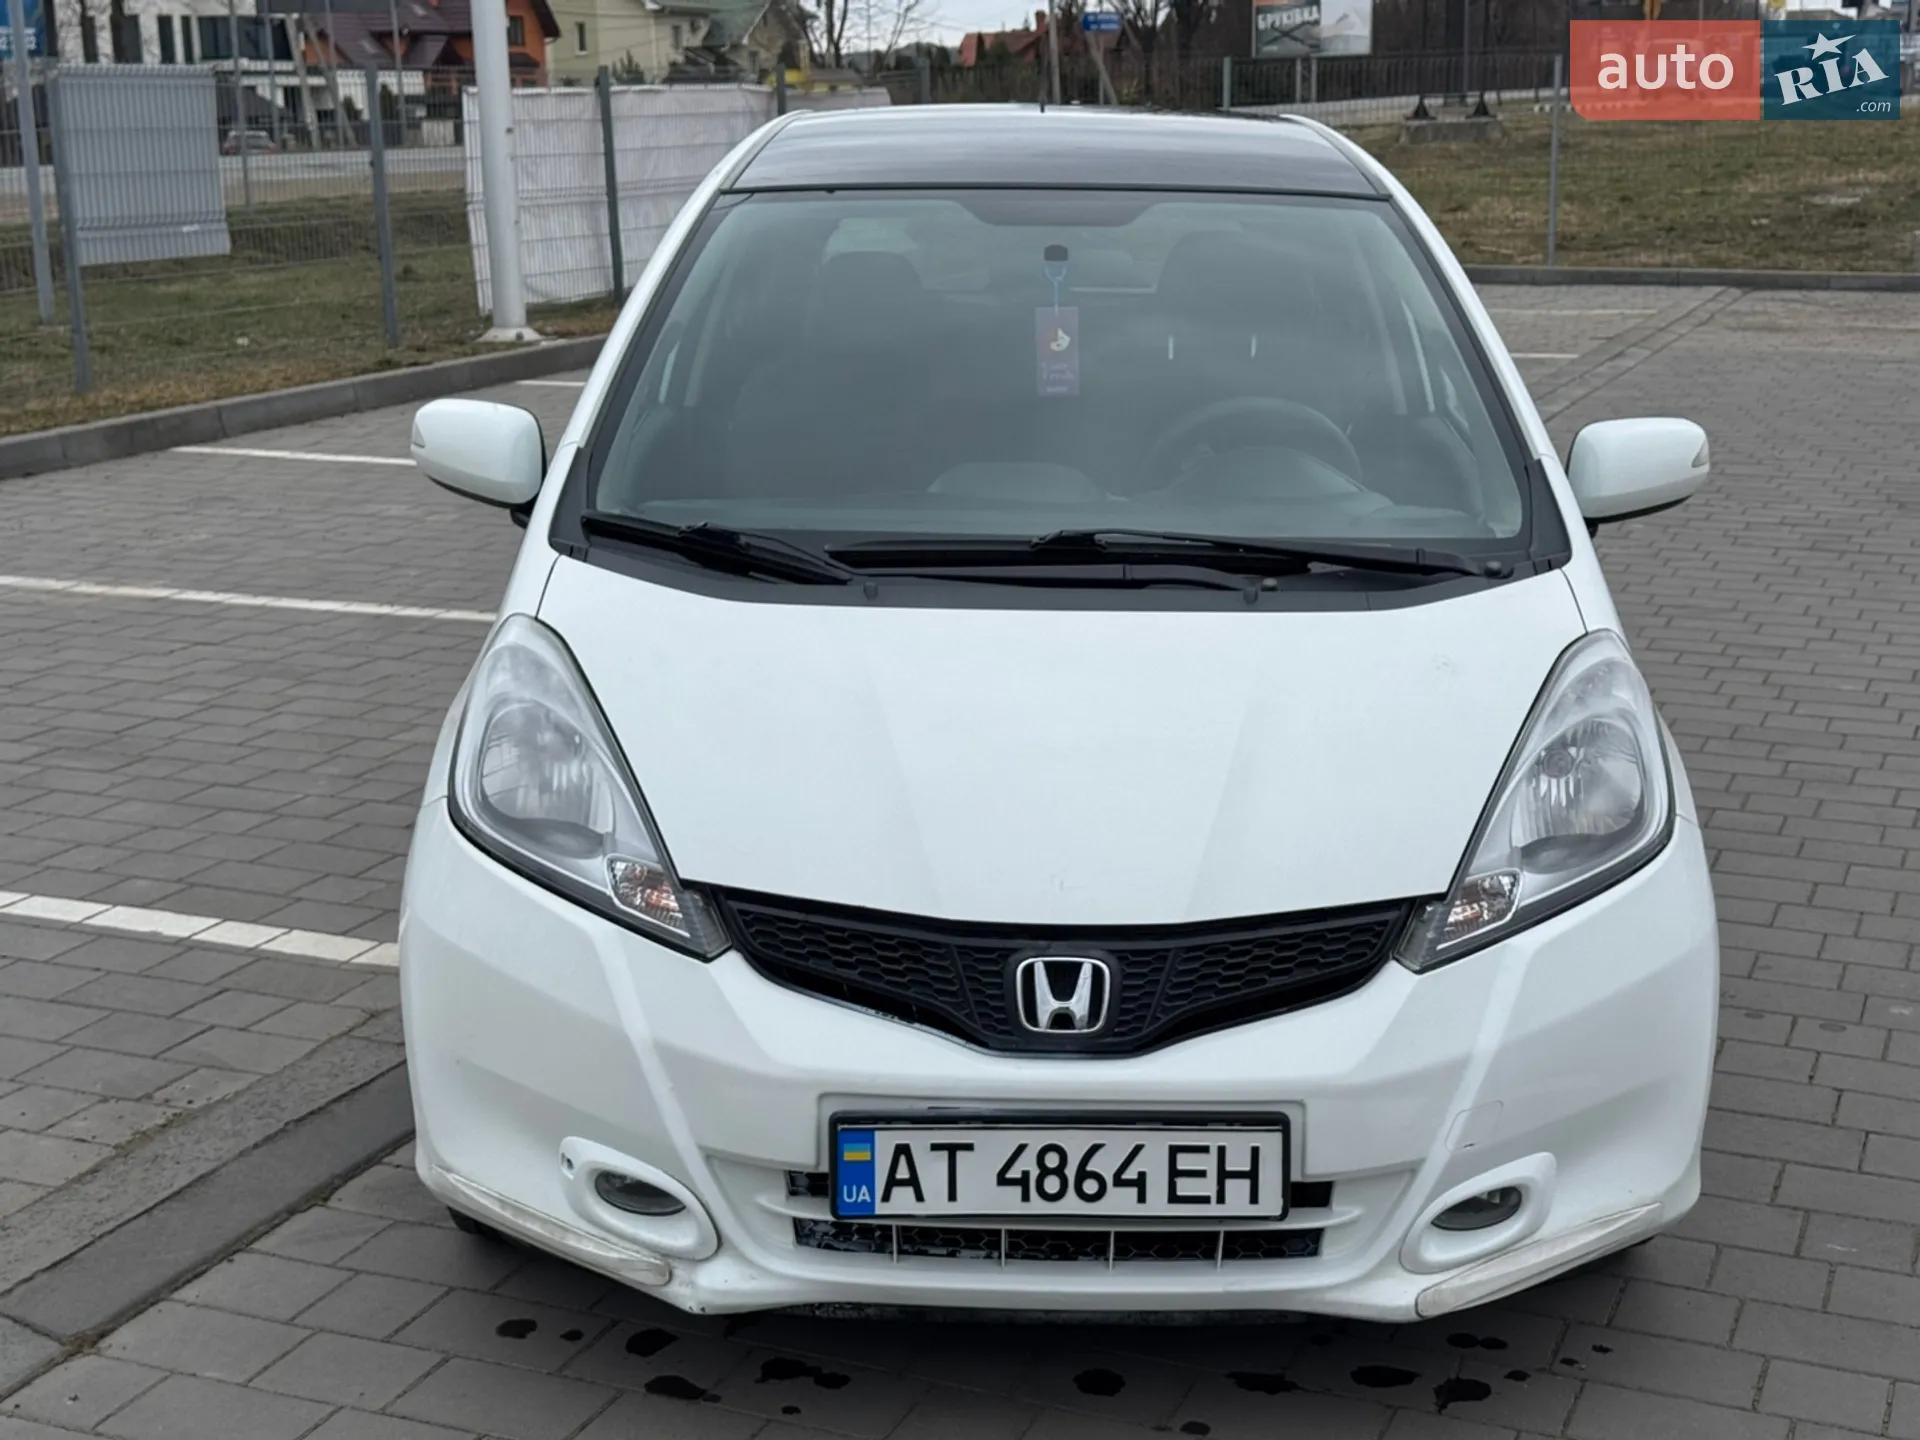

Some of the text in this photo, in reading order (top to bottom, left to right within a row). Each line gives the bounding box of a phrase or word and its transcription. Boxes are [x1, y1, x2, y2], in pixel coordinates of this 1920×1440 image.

[843, 1185, 871, 1203] UA
[880, 1143, 1260, 1205] AT 4864 EH
